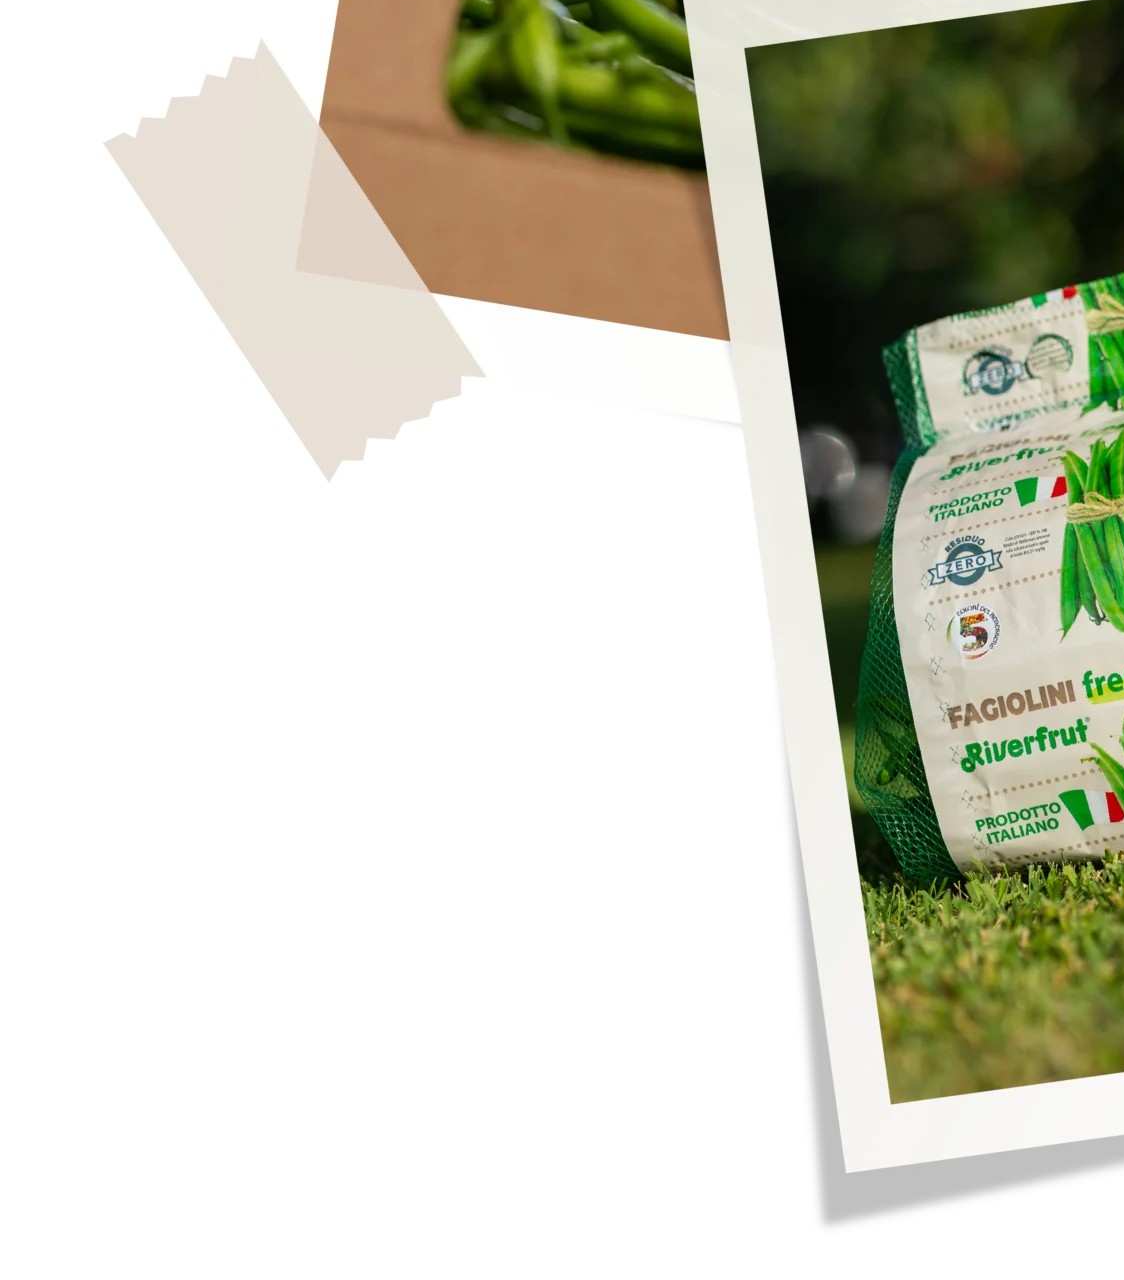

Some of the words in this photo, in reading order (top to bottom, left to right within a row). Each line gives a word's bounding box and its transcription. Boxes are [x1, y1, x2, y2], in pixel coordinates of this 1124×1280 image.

[940, 444, 1066, 481] Riverfrut
[929, 486, 1012, 513] PRODOTTO
[934, 498, 1004, 522] ITALIANO
[944, 535, 986, 553] RESIDUO
[945, 554, 987, 574] ZERO
[948, 679, 1077, 730] FAGIOLINI
[961, 718, 1088, 773] Riverfrut
[975, 802, 1062, 832] PRODOTTO
[985, 817, 1060, 845] ITALIANO
